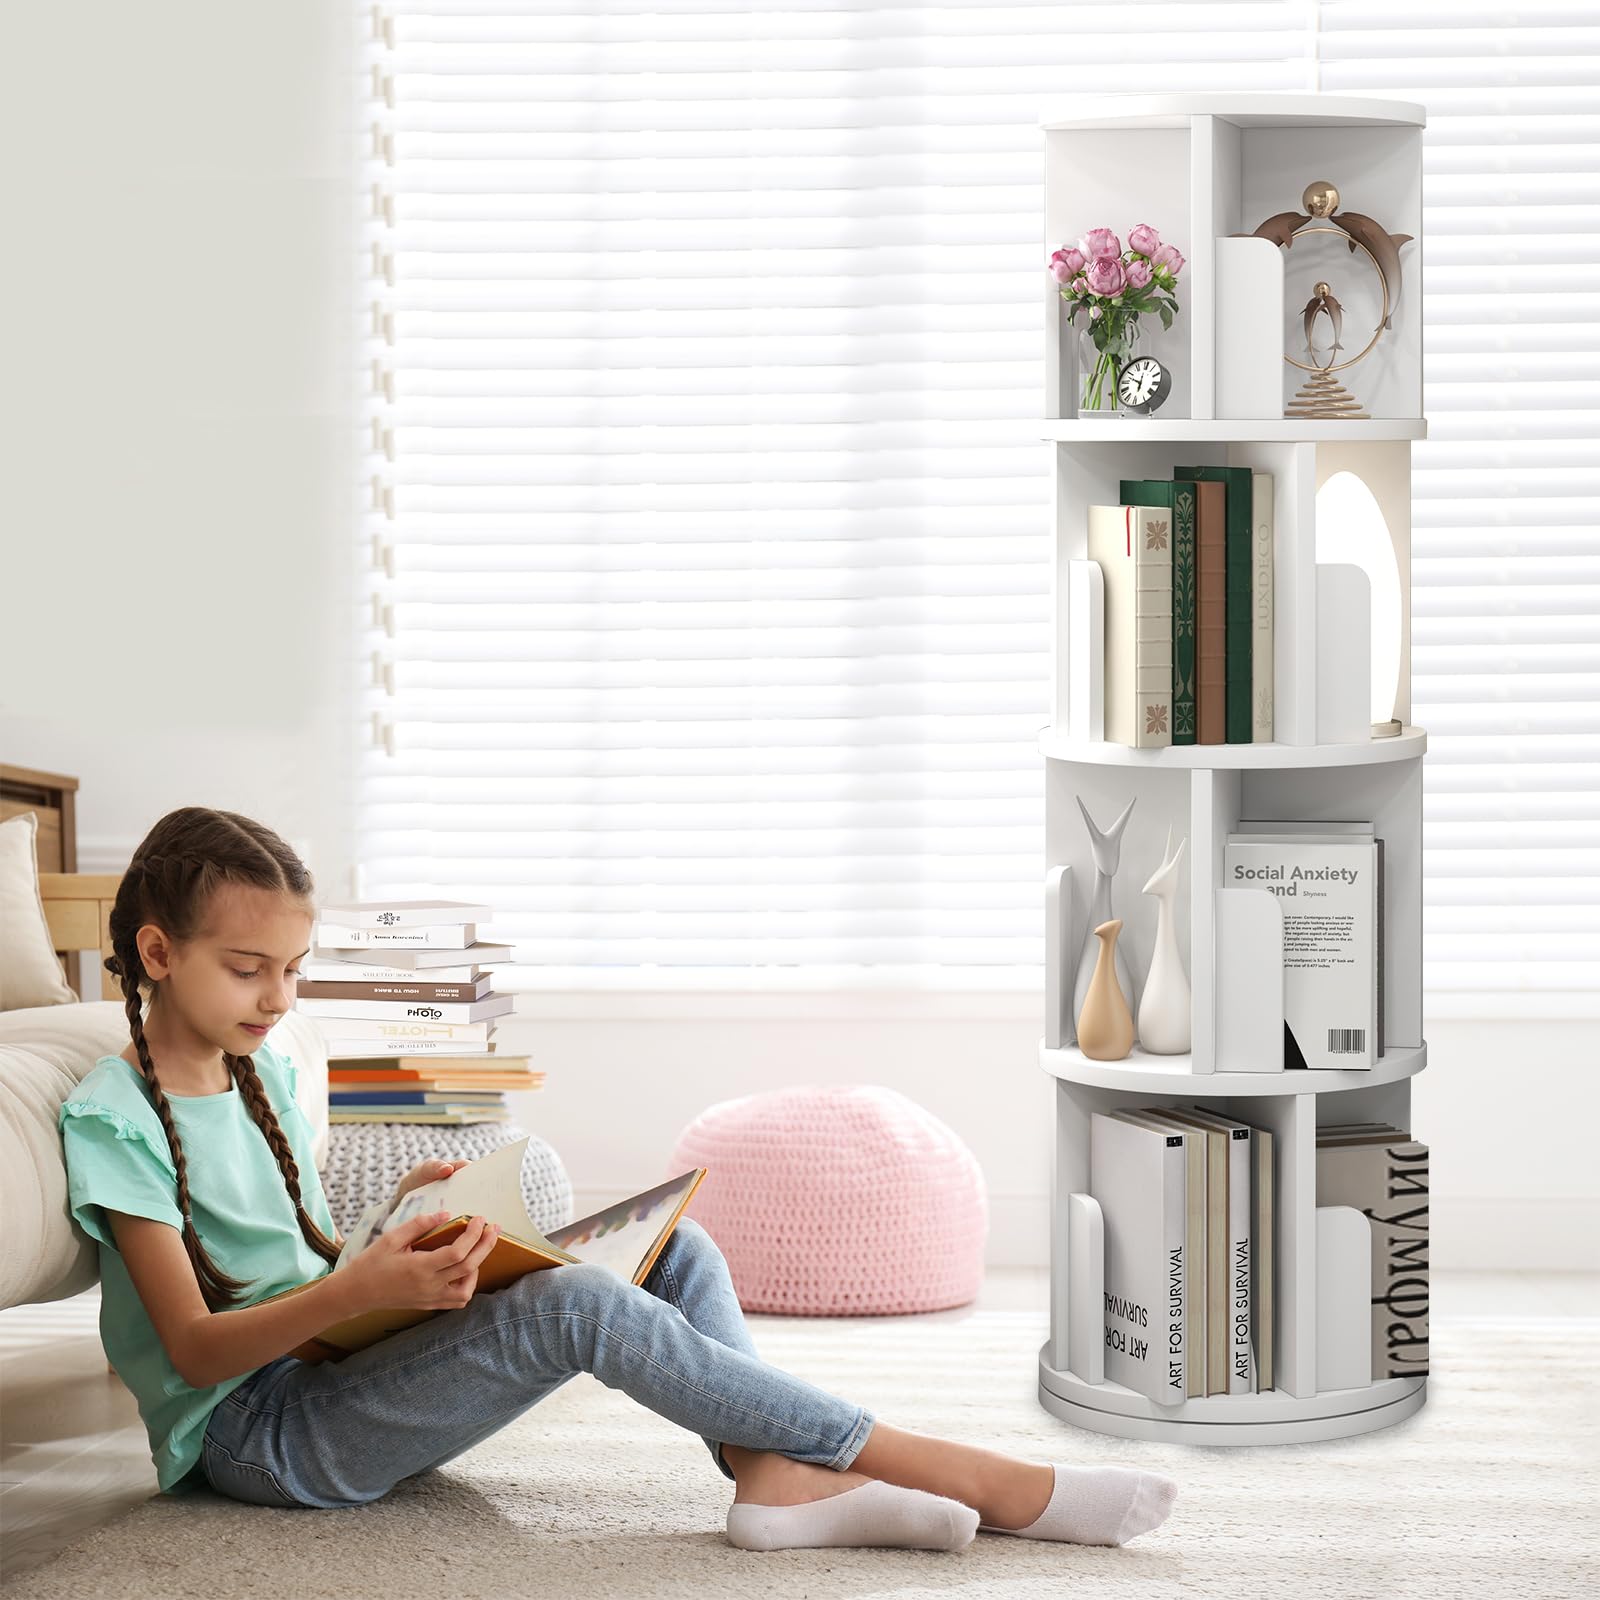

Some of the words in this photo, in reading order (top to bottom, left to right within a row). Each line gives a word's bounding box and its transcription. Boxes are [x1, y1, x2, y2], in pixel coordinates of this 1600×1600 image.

[1258, 523, 1270, 630] LUXDECO
[1234, 865, 1284, 880] Social
[1290, 866, 1358, 885] Anxiety
[1303, 890, 1327, 898] Shyness
[407, 1007, 442, 1018] PHOTO
[378, 1025, 453, 1038] HOTEL
[1168, 1246, 1182, 1316] SURVIVAL
[1236, 1238, 1248, 1310] SURVIVAL
[1104, 1291, 1148, 1328] SURVIVAL
[1106, 1326, 1125, 1352] FOR
[1168, 1322, 1182, 1354] FOR
[1236, 1314, 1248, 1346] FOR
[1129, 1336, 1148, 1361] ART
[1168, 1360, 1182, 1388] ART
[1236, 1349, 1248, 1379] ART
